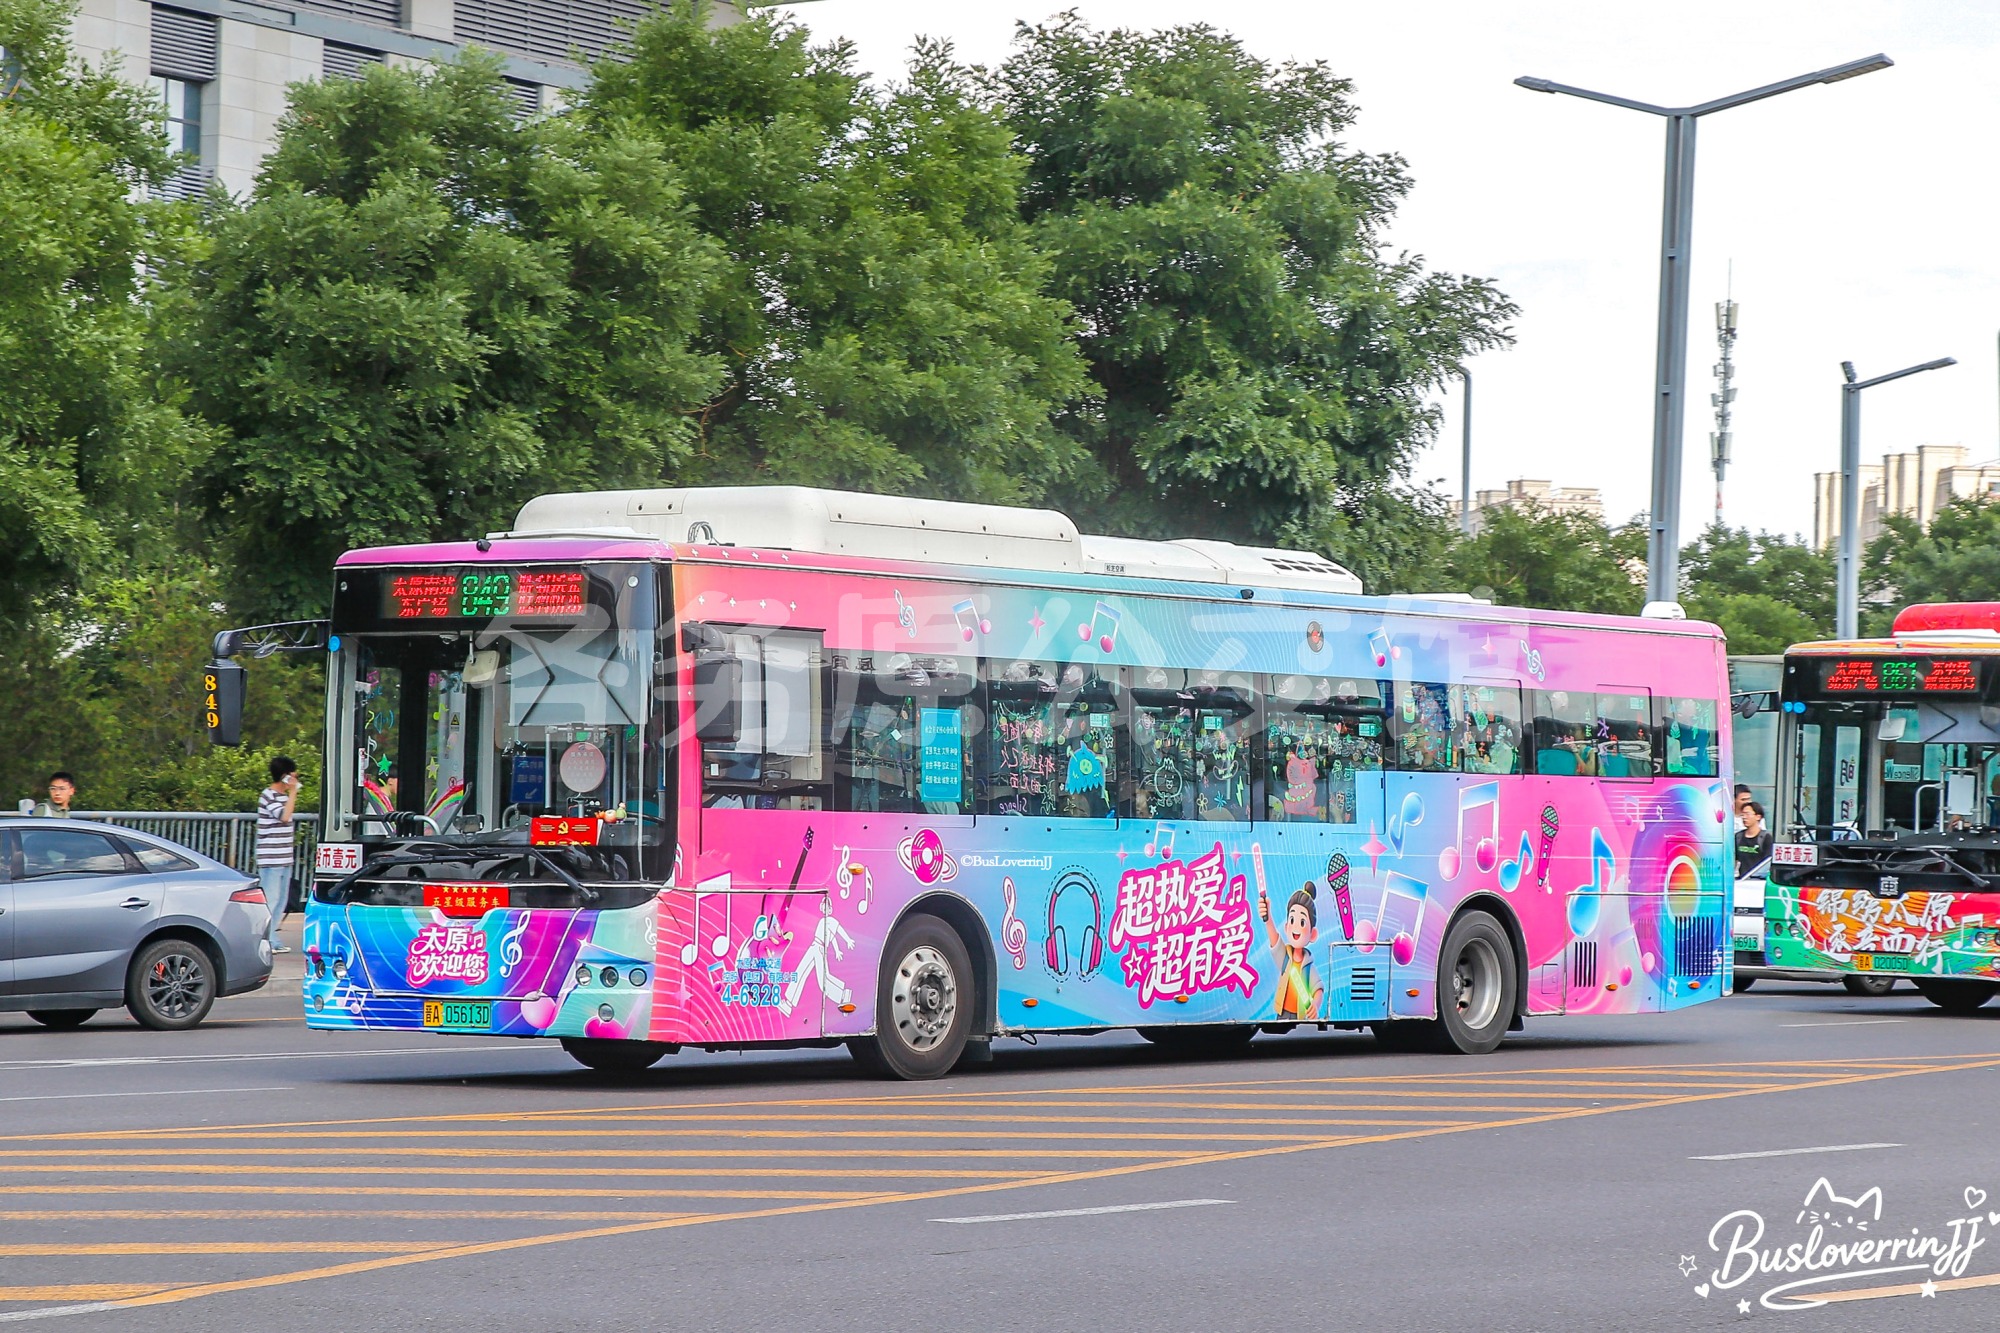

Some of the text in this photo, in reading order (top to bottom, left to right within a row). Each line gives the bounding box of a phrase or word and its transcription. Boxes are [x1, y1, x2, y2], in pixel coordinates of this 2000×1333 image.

[204, 674, 219, 728] 849
[1775, 846, 1813, 862] 投币壹元
[432, 896, 500, 909] 五星级服务车
[1112, 851, 1225, 946] 超热爱
[1816, 889, 1956, 933] 锦绣太原
[411, 926, 471, 955] 太原
[1142, 908, 1255, 1002] 超有爱
[410, 953, 486, 985] 欢迎您
[722, 983, 782, 1005] 4-6328
